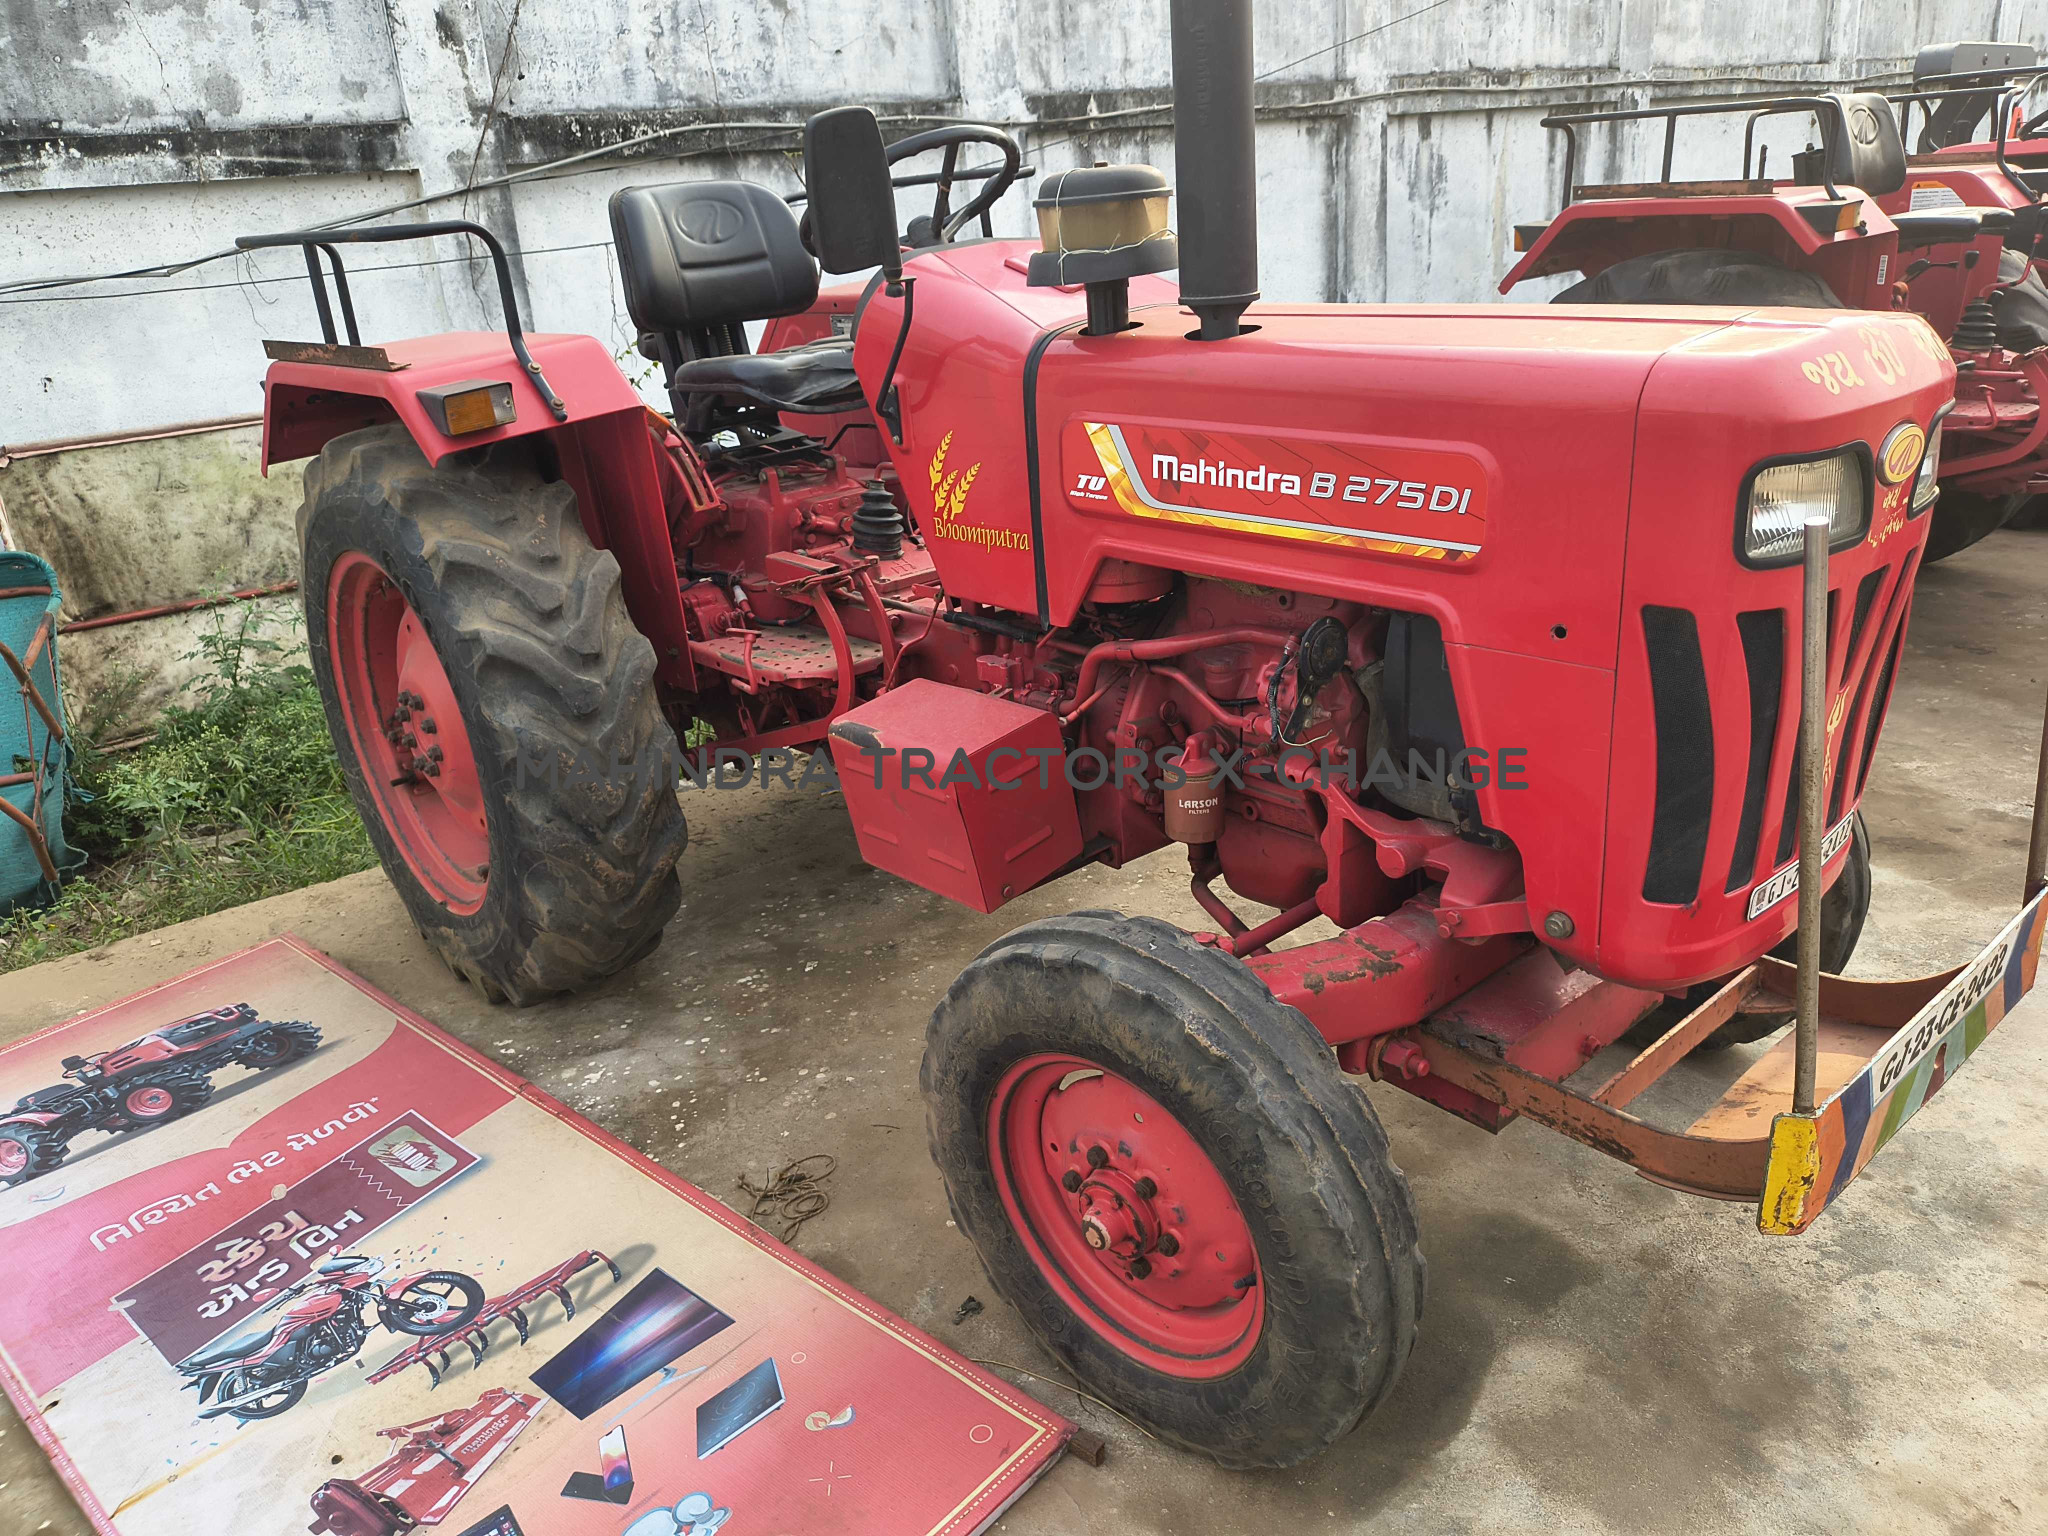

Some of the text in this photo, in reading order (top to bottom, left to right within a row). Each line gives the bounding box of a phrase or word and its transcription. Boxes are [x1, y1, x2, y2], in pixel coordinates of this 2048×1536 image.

[1076, 474, 1106, 491] TU
[1309, 472, 1336, 499] B
[1069, 490, 1087, 498] High
[933, 516, 1031, 554] Bhoomiputra
[1178, 797, 1218, 809] LARSON
[89, 1182, 222, 1252] નિશ્ચિત
[227, 1151, 286, 1184] ભેટ
